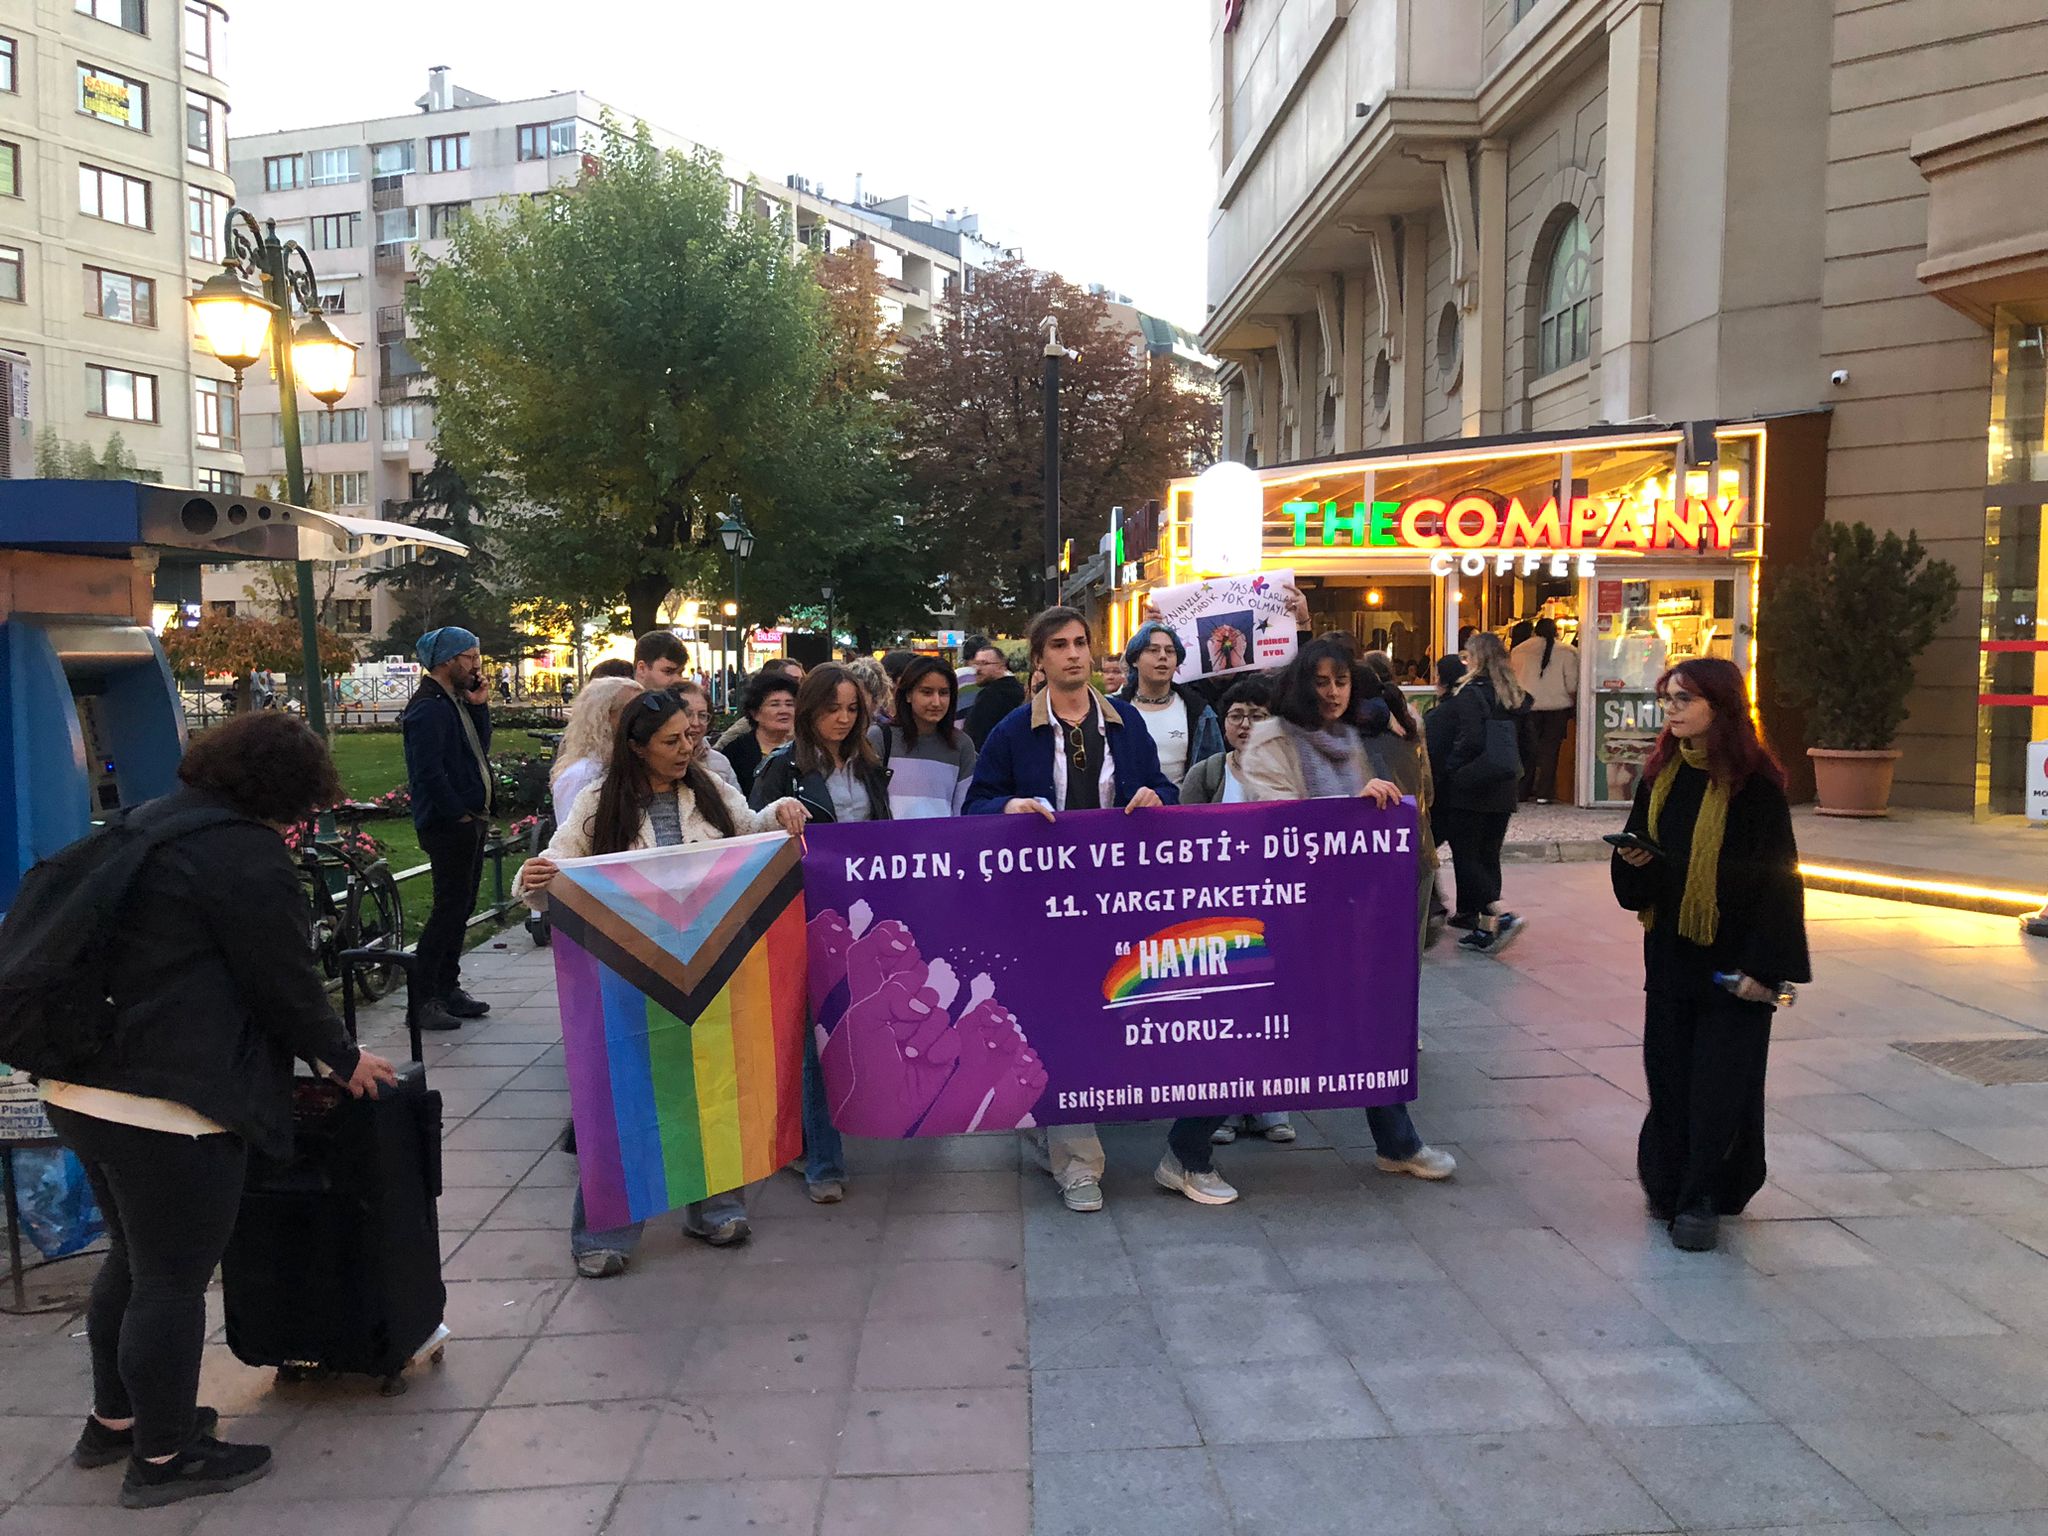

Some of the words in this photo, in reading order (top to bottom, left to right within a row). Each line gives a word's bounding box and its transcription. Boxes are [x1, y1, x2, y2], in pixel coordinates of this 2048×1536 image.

[1281, 501, 1401, 547] THE
[1400, 496, 1750, 550] COMPANY
[1430, 554, 1597, 577] COFFEE
[1222, 592, 1244, 606] YOK
[845, 852, 965, 881] KADIN,
[979, 845, 1077, 882] ÇOCUK
[1089, 843, 1125, 868] VE
[1138, 830, 1250, 866] LGBTİ+
[1263, 827, 1411, 864] DÜŞMANI
[1045, 895, 1088, 918] 11.
[1096, 888, 1175, 914] YARGI
[1182, 878, 1307, 909] PAKETİNE
[1125, 1014, 1290, 1046] DİYORUZ...!!!
[1058, 1084, 1143, 1112] ESKİŞEHİR
[1150, 1077, 1256, 1103] DEMOKRATİK
[1262, 1076, 1310, 1097] KADIN
[1318, 1068, 1409, 1093] PLATFORMU
